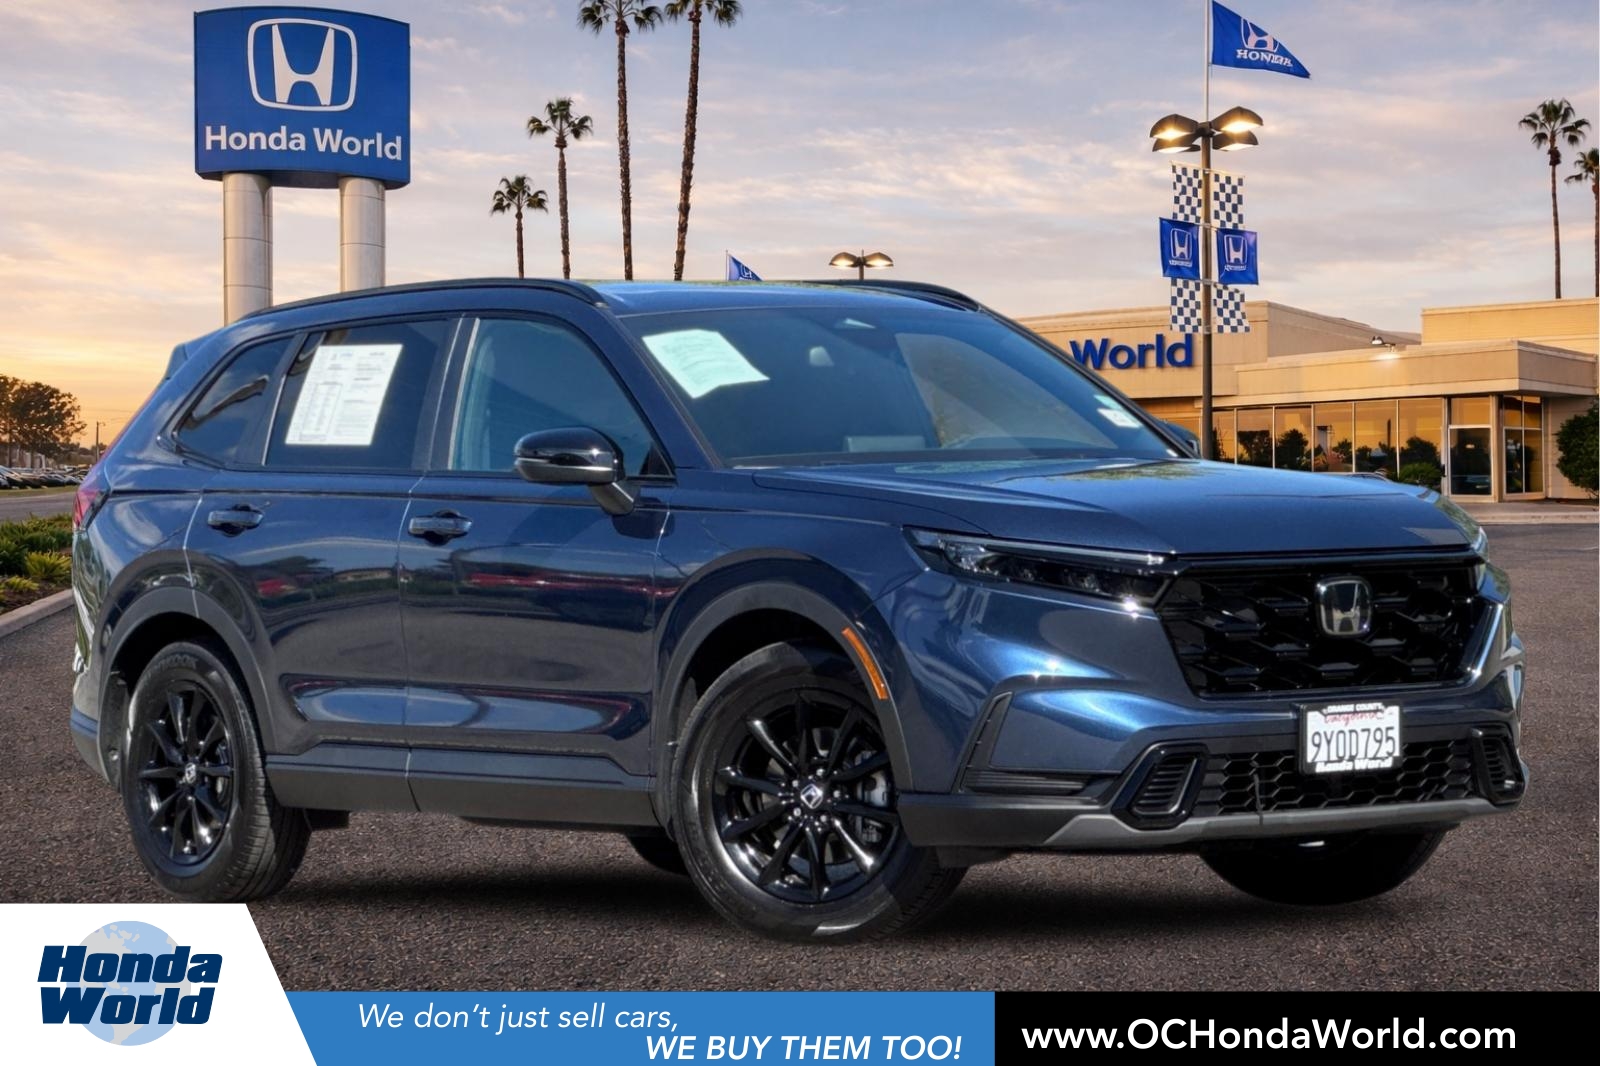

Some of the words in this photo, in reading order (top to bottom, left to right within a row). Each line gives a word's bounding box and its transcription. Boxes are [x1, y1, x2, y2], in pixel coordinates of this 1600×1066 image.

[205, 125, 306, 151] Honda
[313, 127, 402, 160] World
[1069, 333, 1193, 370] World
